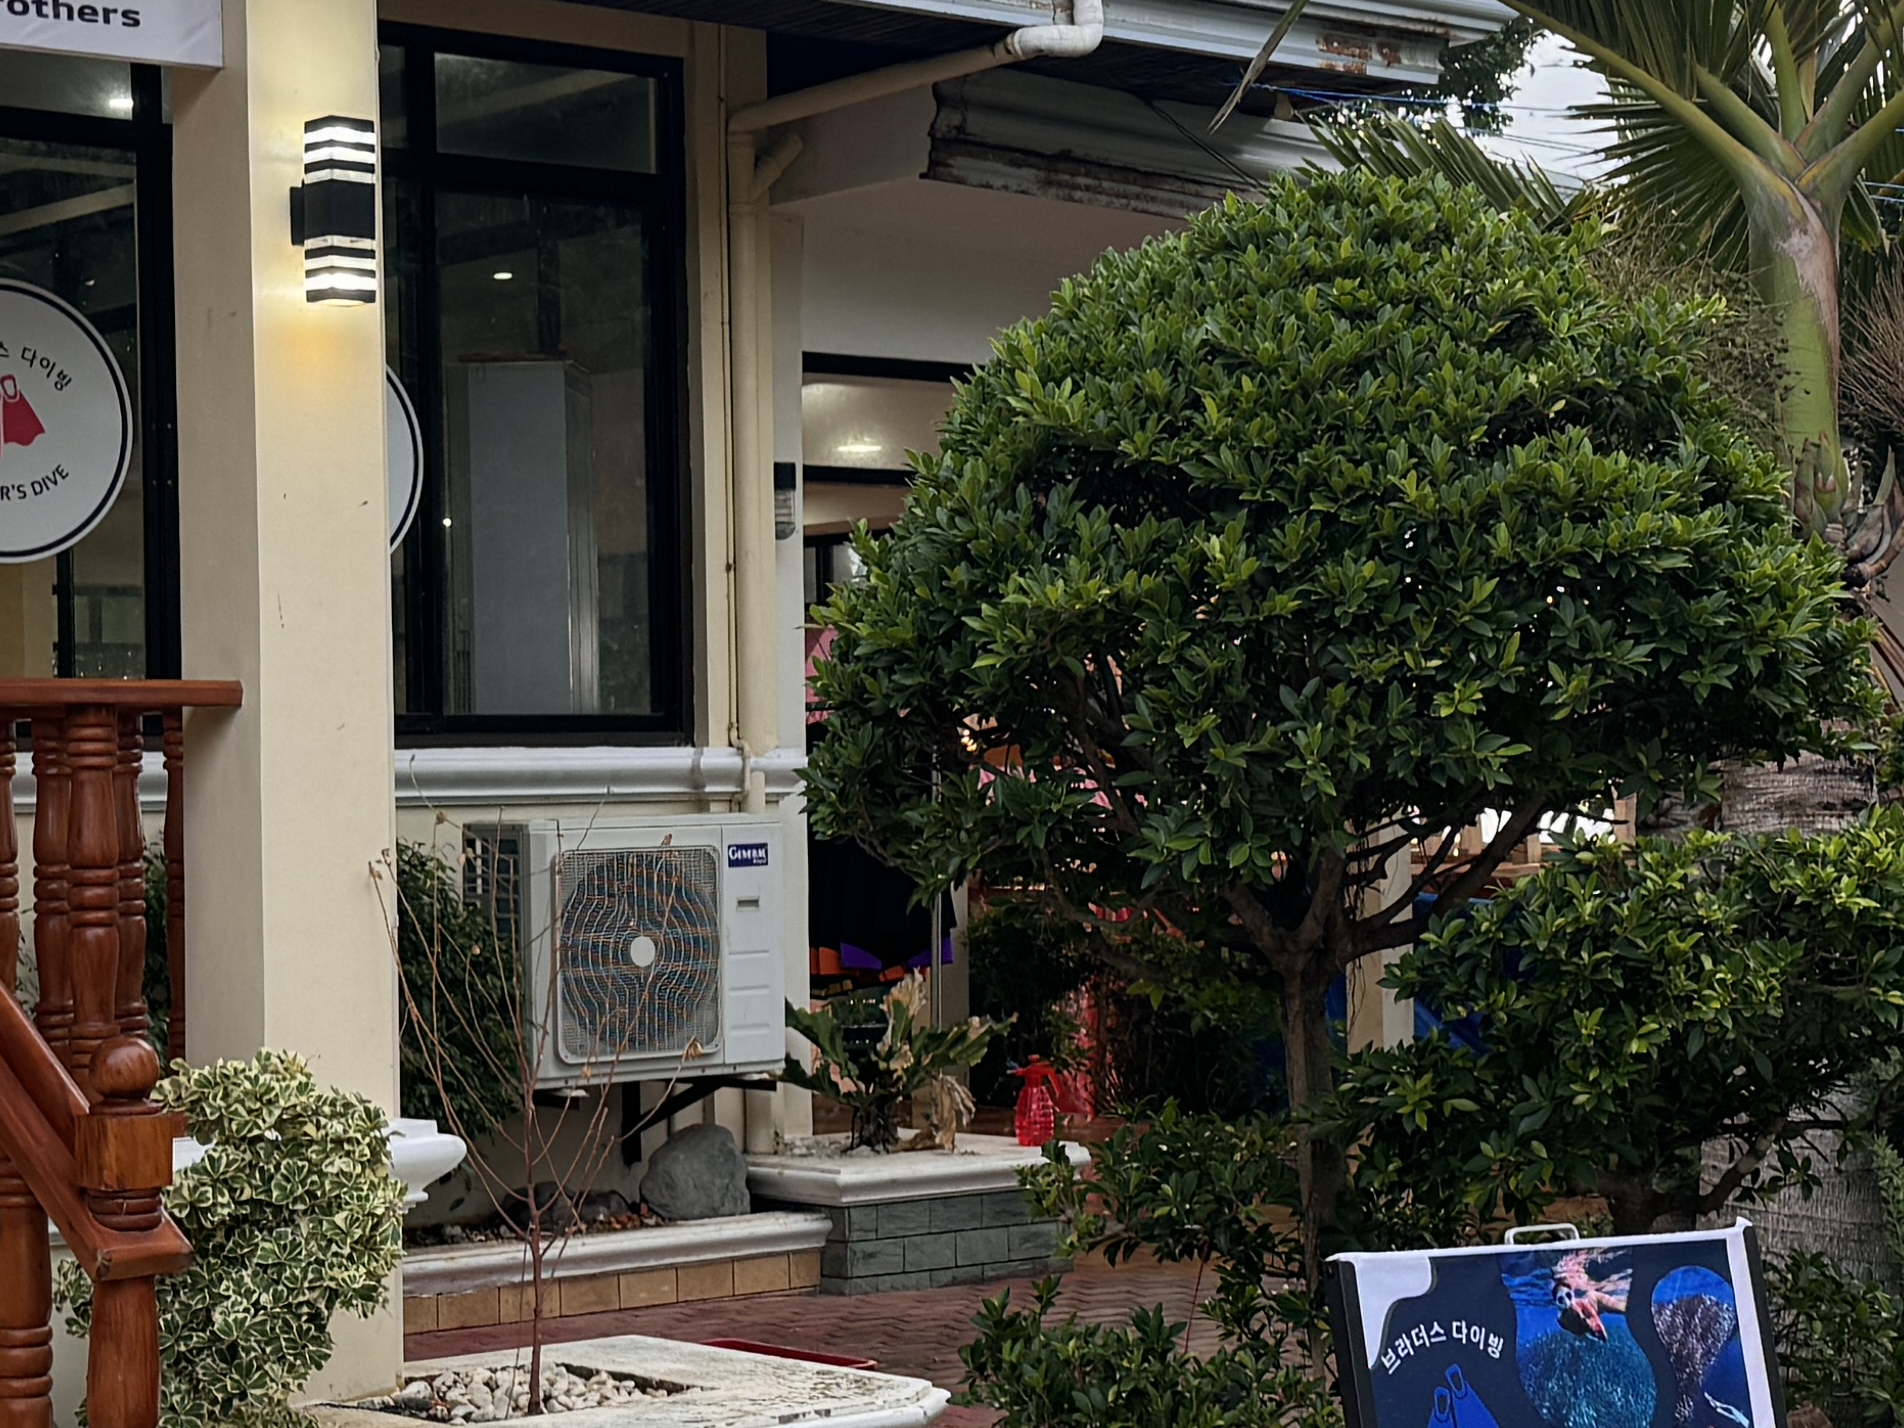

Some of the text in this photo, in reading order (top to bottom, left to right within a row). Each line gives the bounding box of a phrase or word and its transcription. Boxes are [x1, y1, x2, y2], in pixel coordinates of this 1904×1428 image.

[20, 346, 72, 392] 다이빙
[31, 463, 70, 498] DIVE
[1380, 1319, 1504, 1375] 브라더스 다이빙
